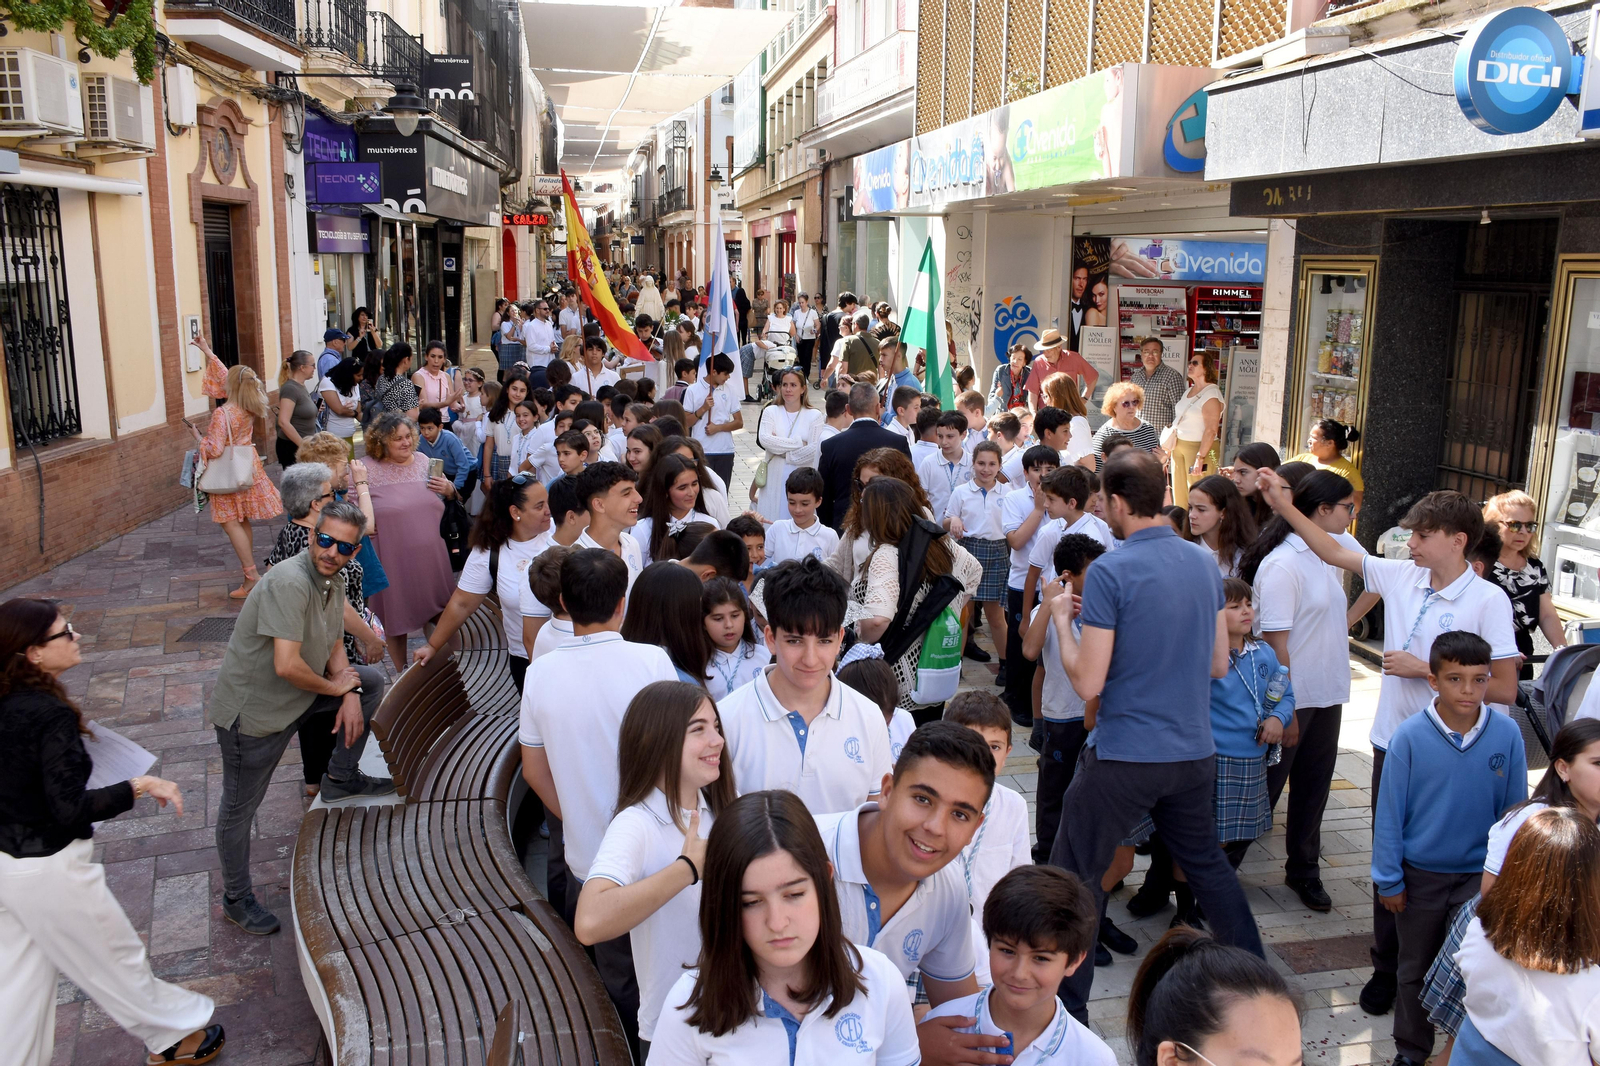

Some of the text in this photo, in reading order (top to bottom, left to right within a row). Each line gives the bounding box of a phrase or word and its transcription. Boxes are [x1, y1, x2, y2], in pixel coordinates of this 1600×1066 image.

[1490, 50, 1552, 63] Distribuidor oficial
[1476, 59, 1562, 88] DIGI
[513, 214, 548, 225] CALZA
[1212, 288, 1252, 297] RIMMEL
